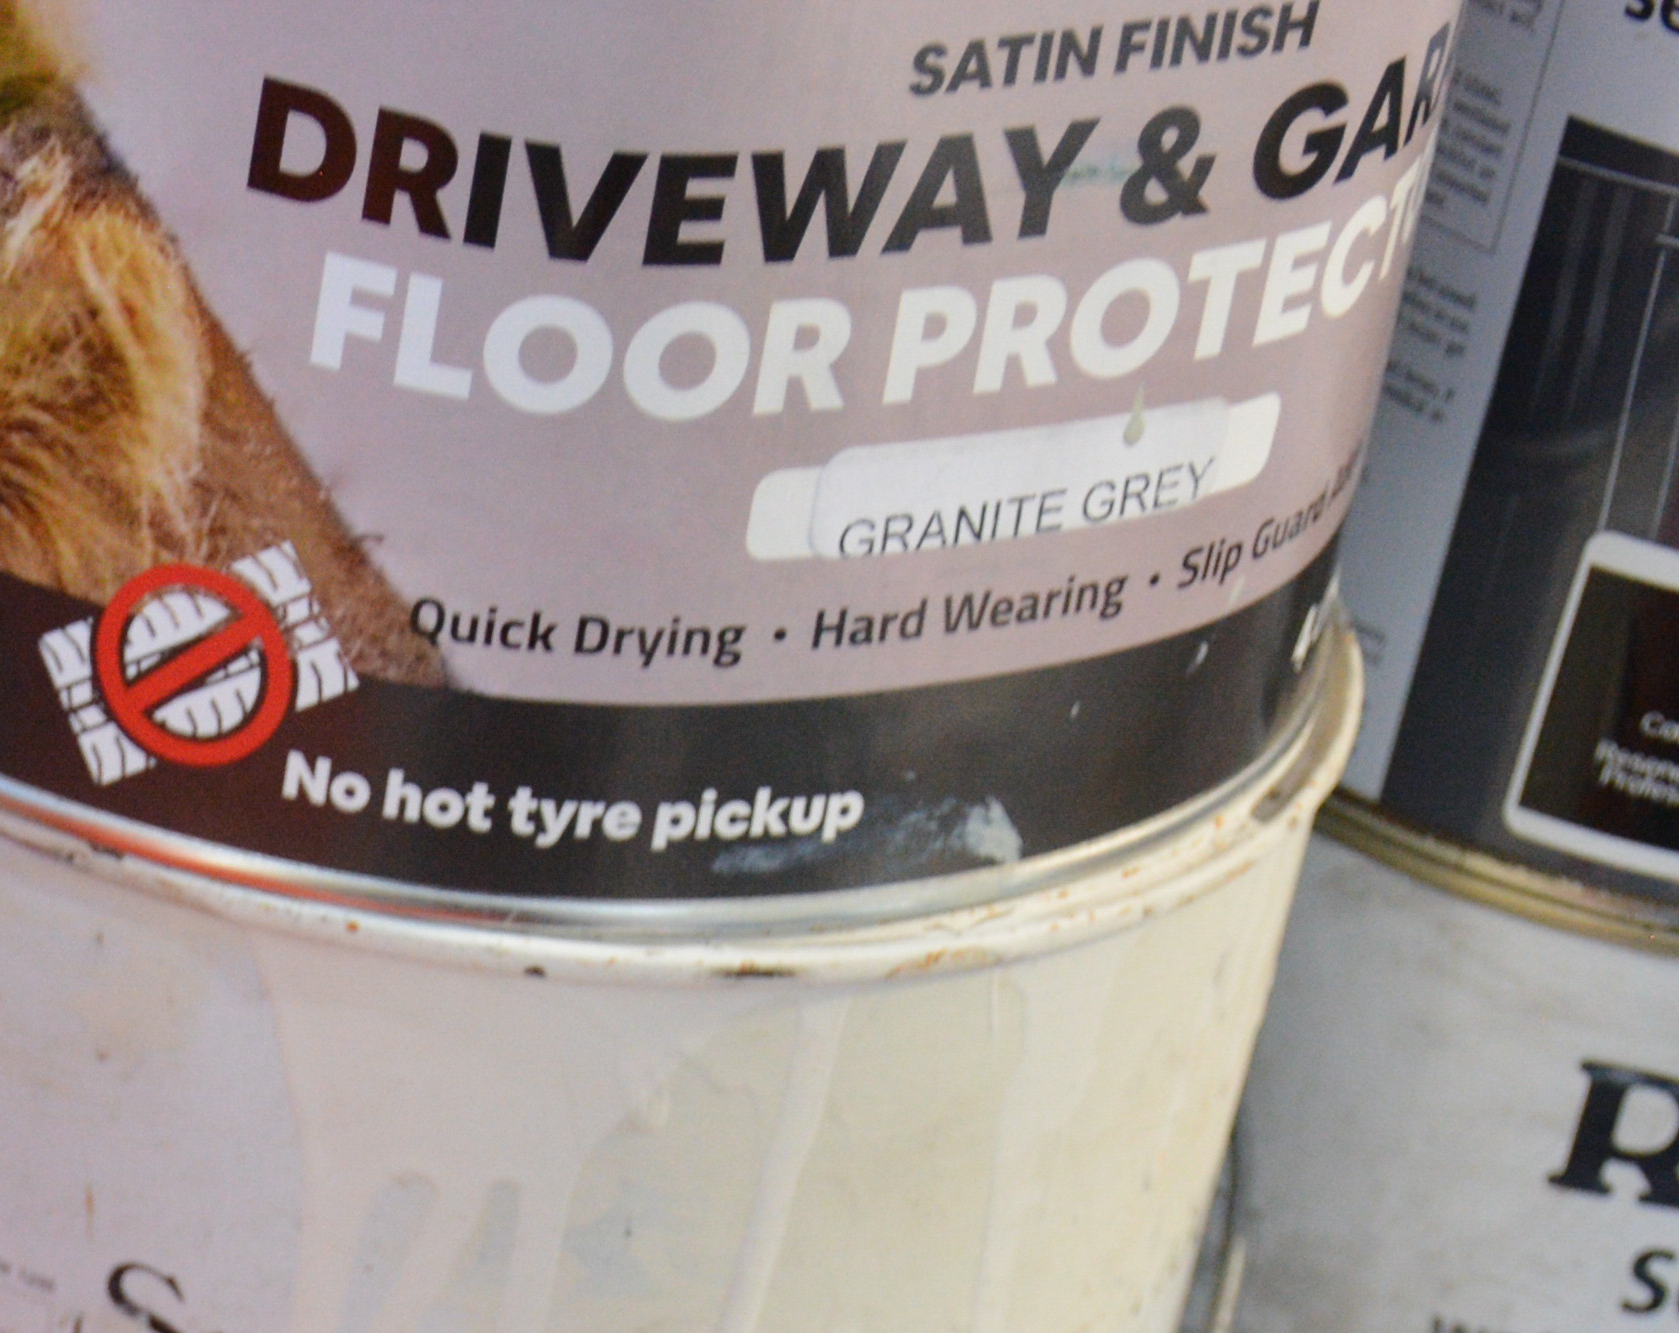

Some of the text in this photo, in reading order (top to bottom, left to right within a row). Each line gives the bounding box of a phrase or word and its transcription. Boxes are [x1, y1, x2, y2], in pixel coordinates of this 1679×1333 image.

[910, 0, 1321, 96] SATIN FINISH
[245, 75, 1102, 267] DRIVEWAY
[1119, 105, 1217, 227] &
[309, 250, 852, 422] FLOOR
[882, 157, 1426, 407] PROTECT
[839, 457, 1217, 558] GRANITE GREY
[409, 597, 558, 654] Quick
[573, 613, 747, 670] Drying
[811, 599, 928, 650] Hard
[943, 573, 1129, 621] Wearing
[1176, 536, 1245, 590] Slip
[281, 750, 866, 853] No hot tyre pickup
